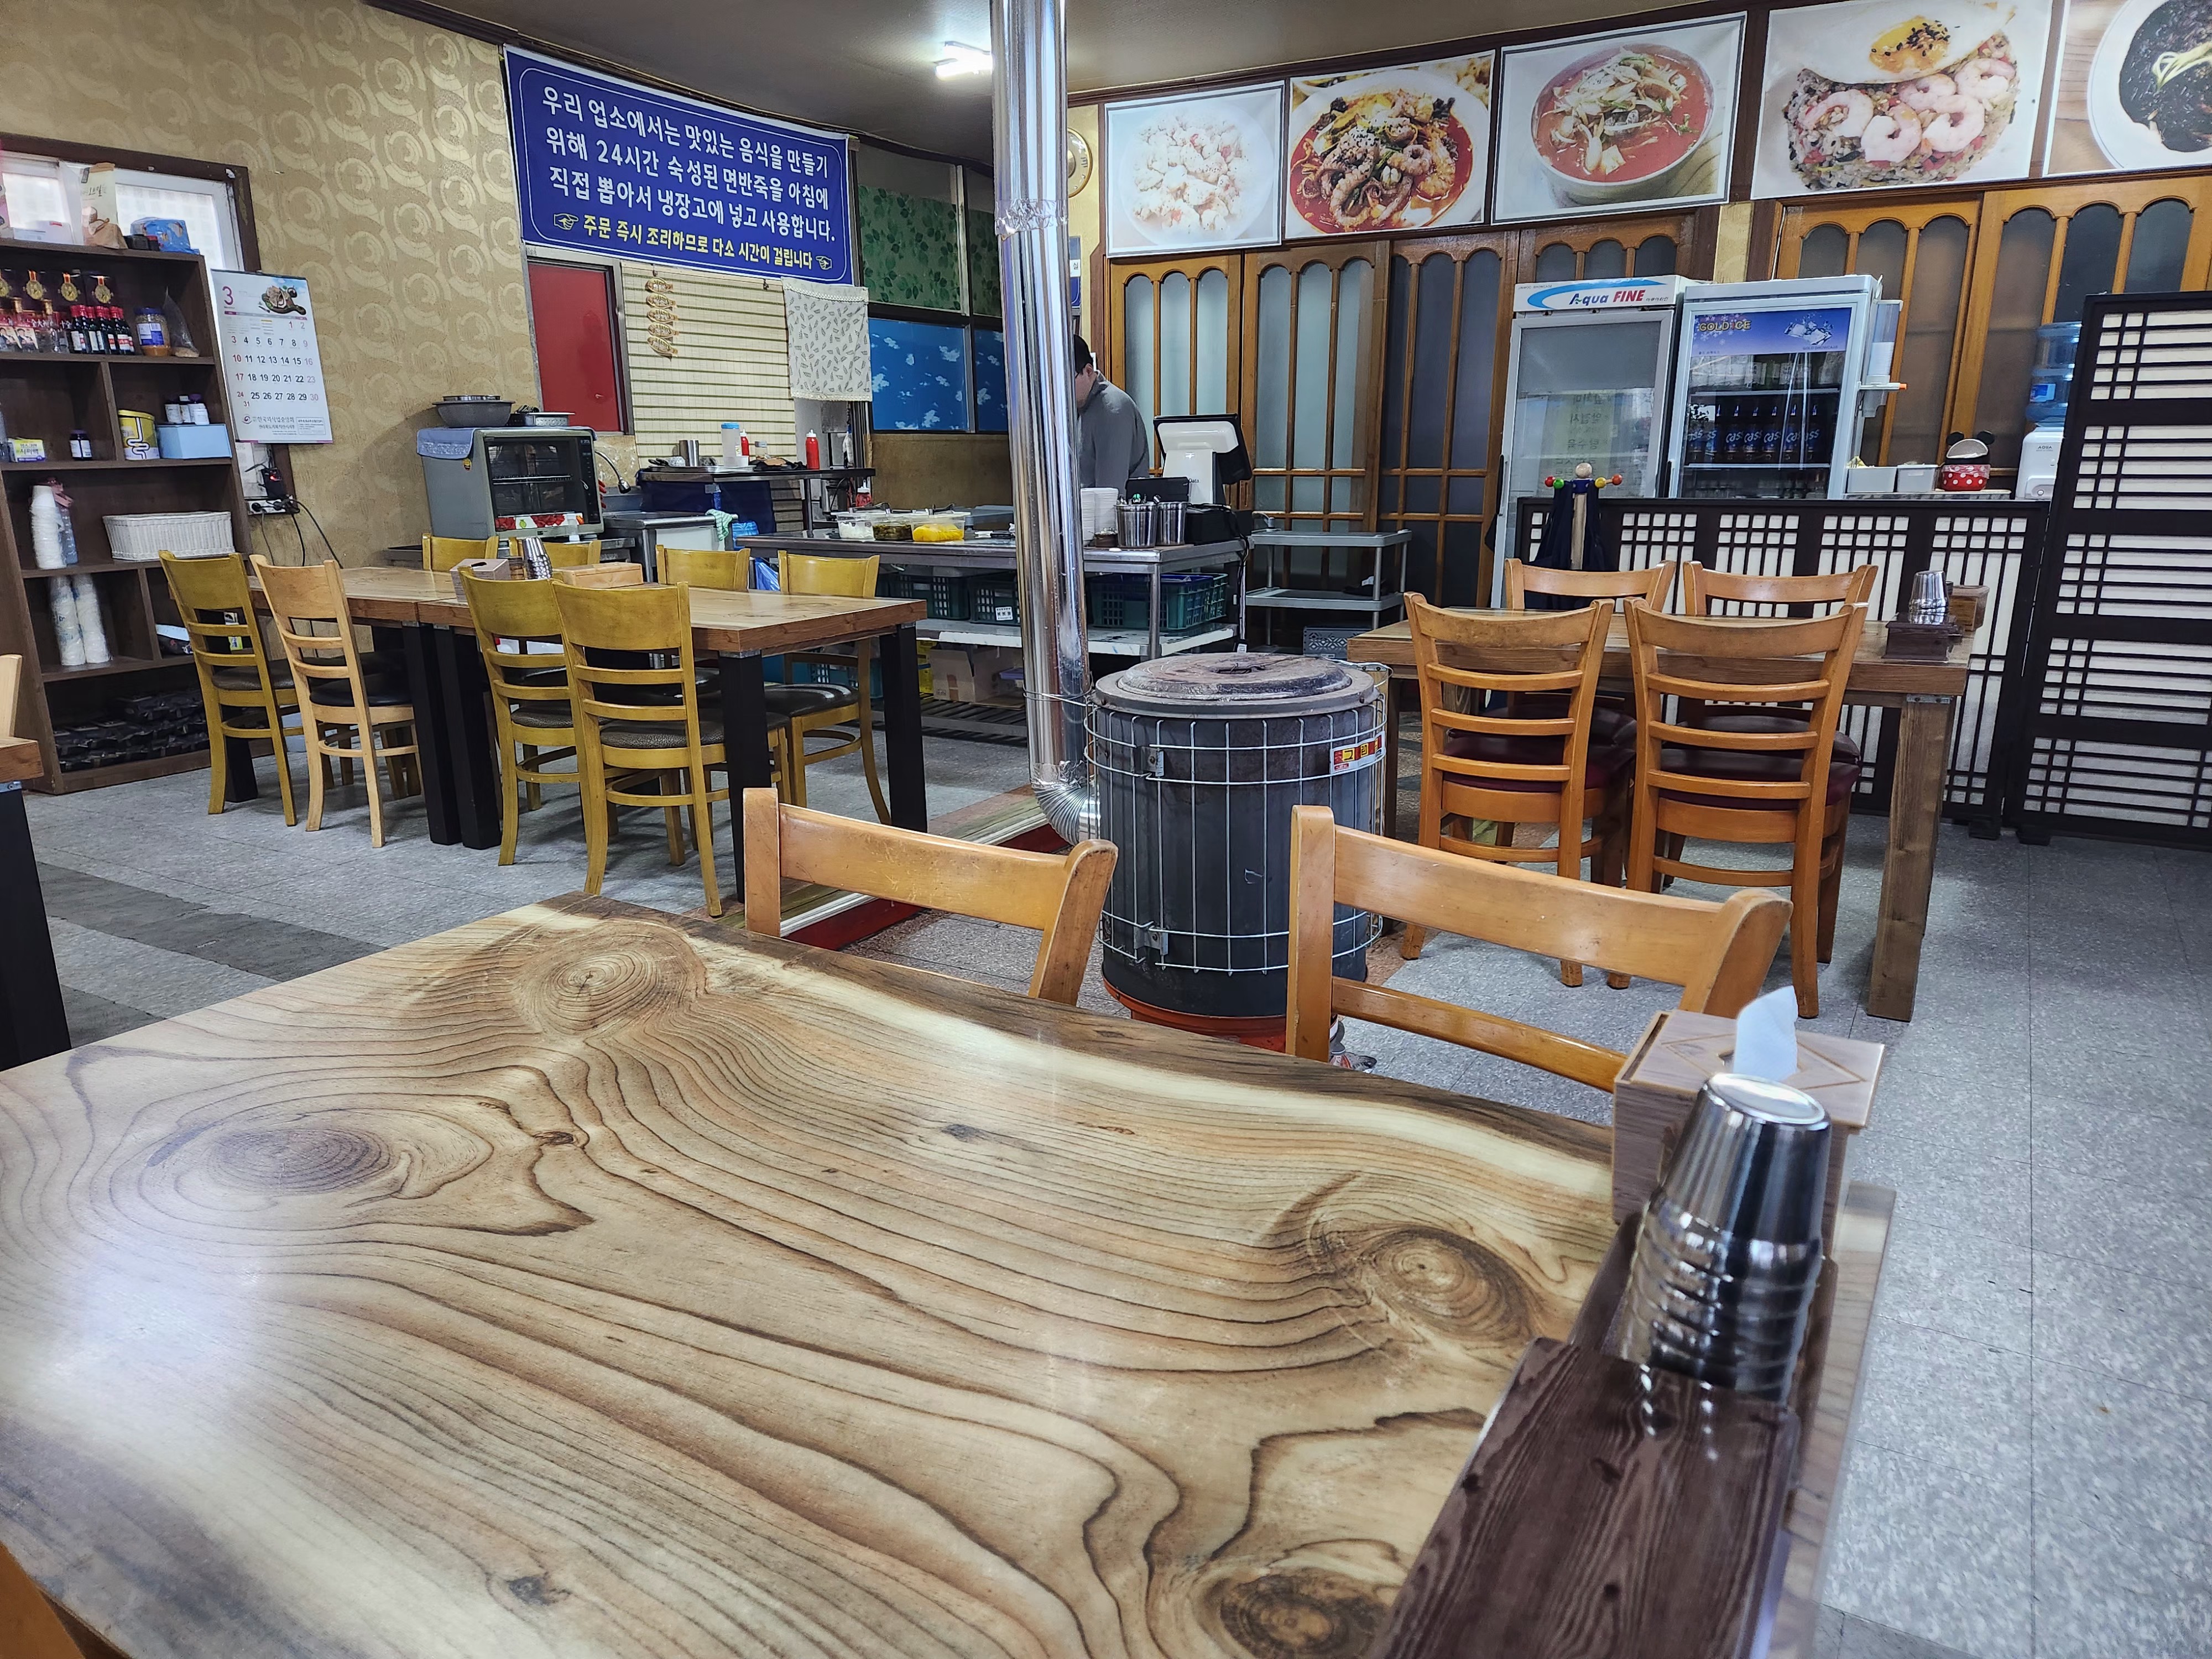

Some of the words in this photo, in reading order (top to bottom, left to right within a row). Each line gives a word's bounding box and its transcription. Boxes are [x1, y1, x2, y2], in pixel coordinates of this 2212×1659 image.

[543, 87, 583, 121] 우리
[589, 100, 680, 146] 업소에서는
[685, 125, 734, 158] 맛있는
[739, 138, 782, 170] 음식을
[787, 150, 827, 178] 만들기
[547, 128, 587, 160] 위해
[597, 140, 659, 177] 24시간
[668, 156, 718, 190] 숙성된
[723, 169, 783, 202] 면반죽을
[789, 182, 828, 210] 아침에
[550, 167, 589, 200] 직접
[598, 176, 651, 211] 뽑아서
[658, 190, 723, 225] 냉장고에
[729, 204, 757, 228] 넣고
[762, 210, 834, 242] 사용합니다.
[584, 215, 611, 238] 주문
[617, 221, 641, 244] 즉시
[647, 228, 708, 253] 조리하므로
[713, 238, 734, 257] 다소
[739, 242, 769, 263] 시간이
[774, 248, 812, 269] 걸립니다
[222, 286, 233, 305] 3
[1569, 293, 1609, 306] Aqua
[1613, 290, 1646, 302] FINE
[1699, 321, 1729, 331] GOLD
[1731, 321, 1751, 330] ICE
